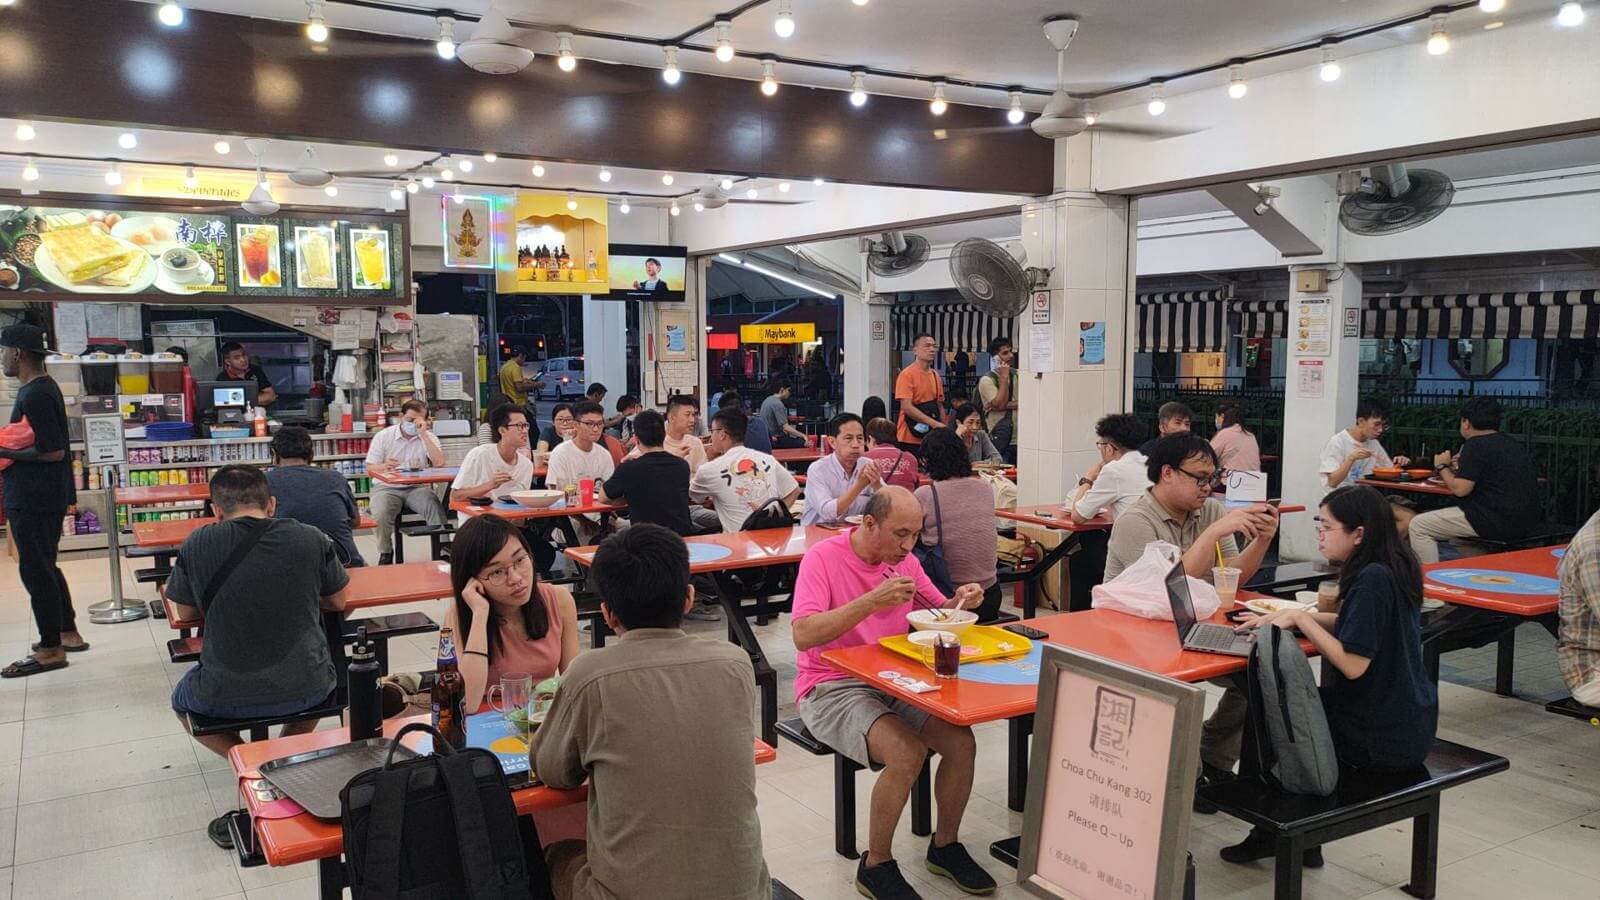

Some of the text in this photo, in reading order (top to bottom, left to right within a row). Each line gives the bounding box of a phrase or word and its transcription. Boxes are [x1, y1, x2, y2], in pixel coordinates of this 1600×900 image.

[764, 328, 796, 340] Maybank
[1061, 758, 1152, 804] Choa Chu Kang 302
[1068, 809, 1098, 831] Please
[1119, 833, 1134, 848] Up
